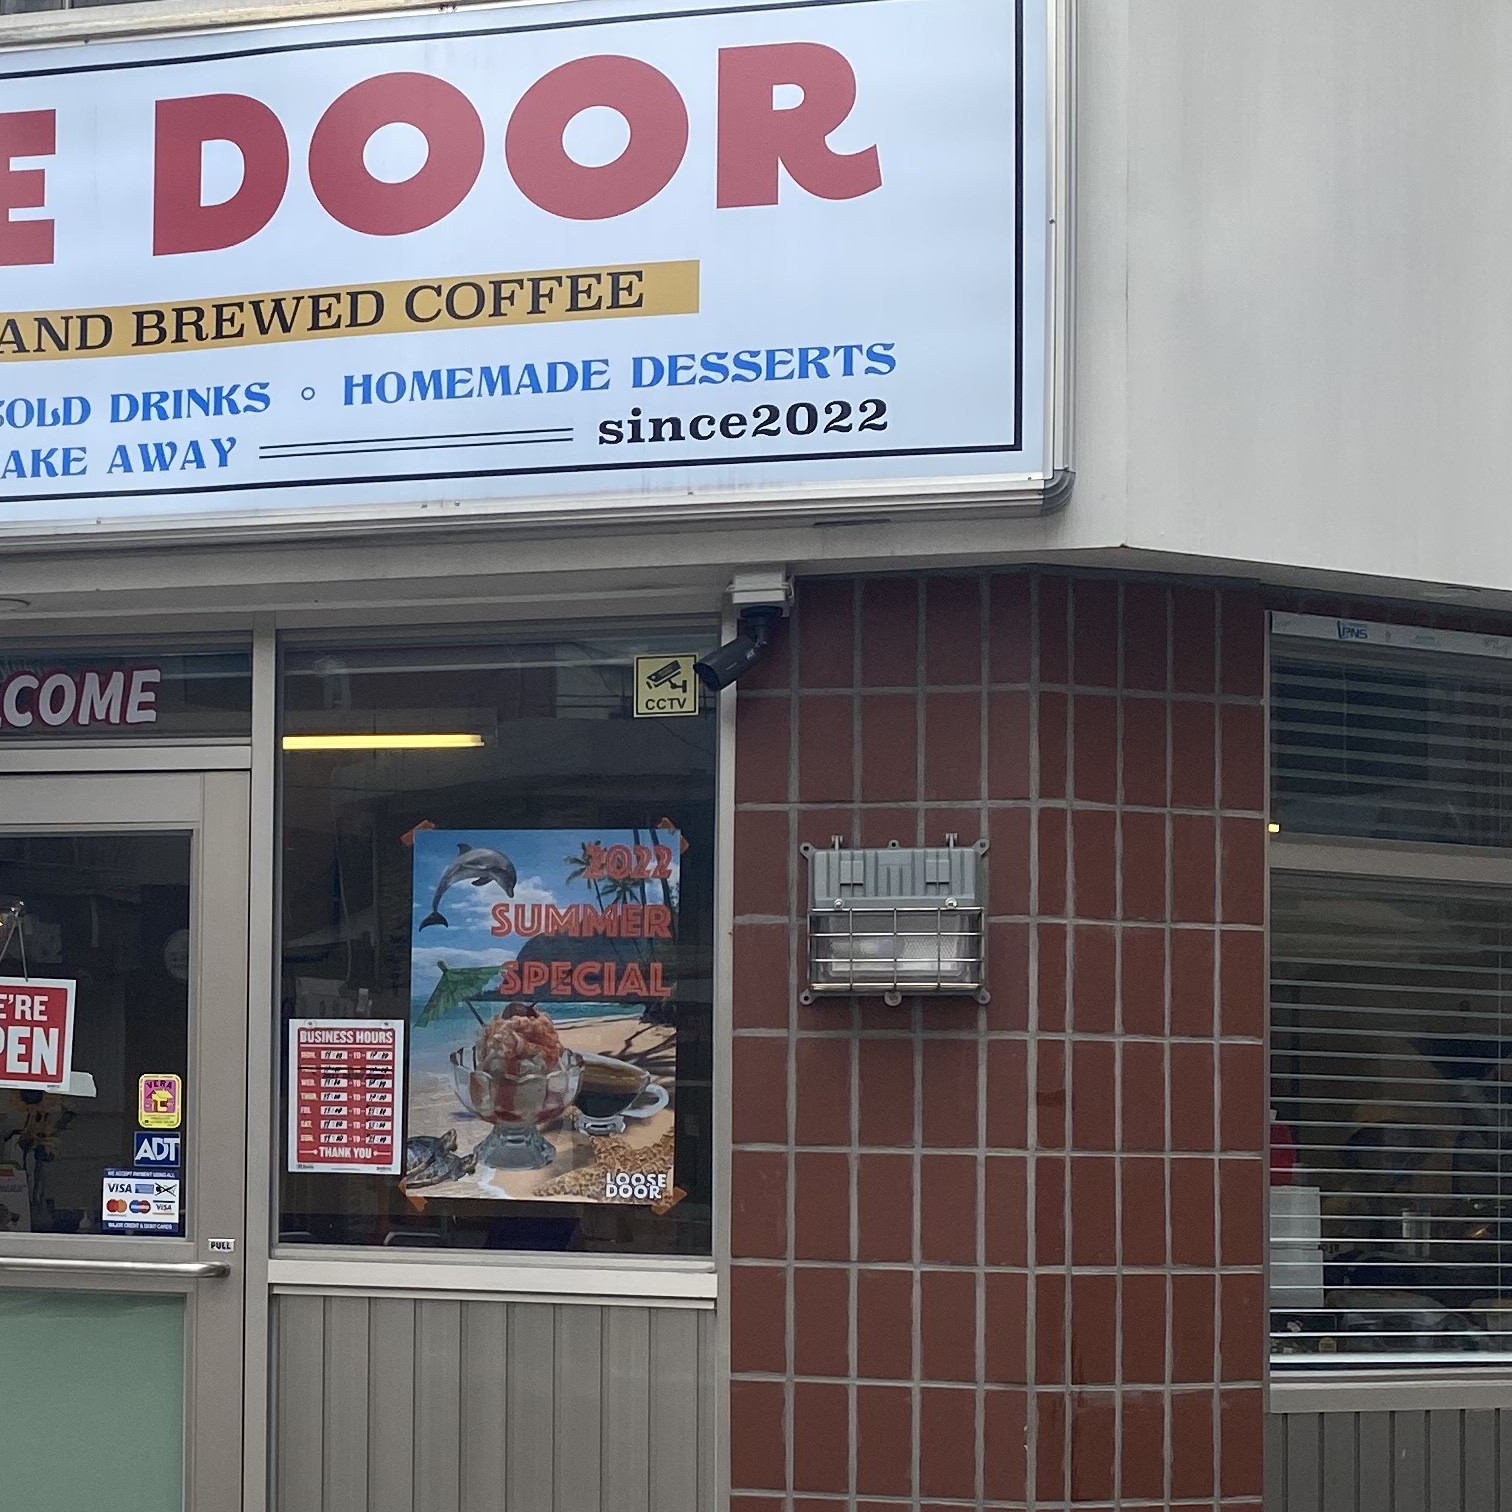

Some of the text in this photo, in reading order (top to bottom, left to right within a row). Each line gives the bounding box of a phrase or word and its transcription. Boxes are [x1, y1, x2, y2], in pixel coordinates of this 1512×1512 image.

[154, 42, 882, 256] DOOR
[131, 290, 385, 347] BREWED
[404, 270, 644, 323] COFFEE
[343, 342, 897, 407] HOMEMADE DESSERTS
[109, 381, 272, 424] DRINKS
[597, 398, 889, 446] since2022
[108, 436, 238, 475] AWAY
[645, 697, 687, 711] CCTV
[583, 843, 674, 881] 2022
[491, 902, 674, 939] SUMMER
[498, 960, 673, 998] SPECIAL
[299, 1030, 394, 1044] BUSINESS HOURS
[145, 1080, 172, 1089] VERA
[134, 1137, 180, 1161] ADT
[319, 1147, 372, 1159] THANK YOU
[107, 1183, 132, 1193] VISA
[605, 1184, 662, 1199] DOOR
[606, 1172, 667, 1188] LOOSE
[210, 1241, 231, 1250] PULL
